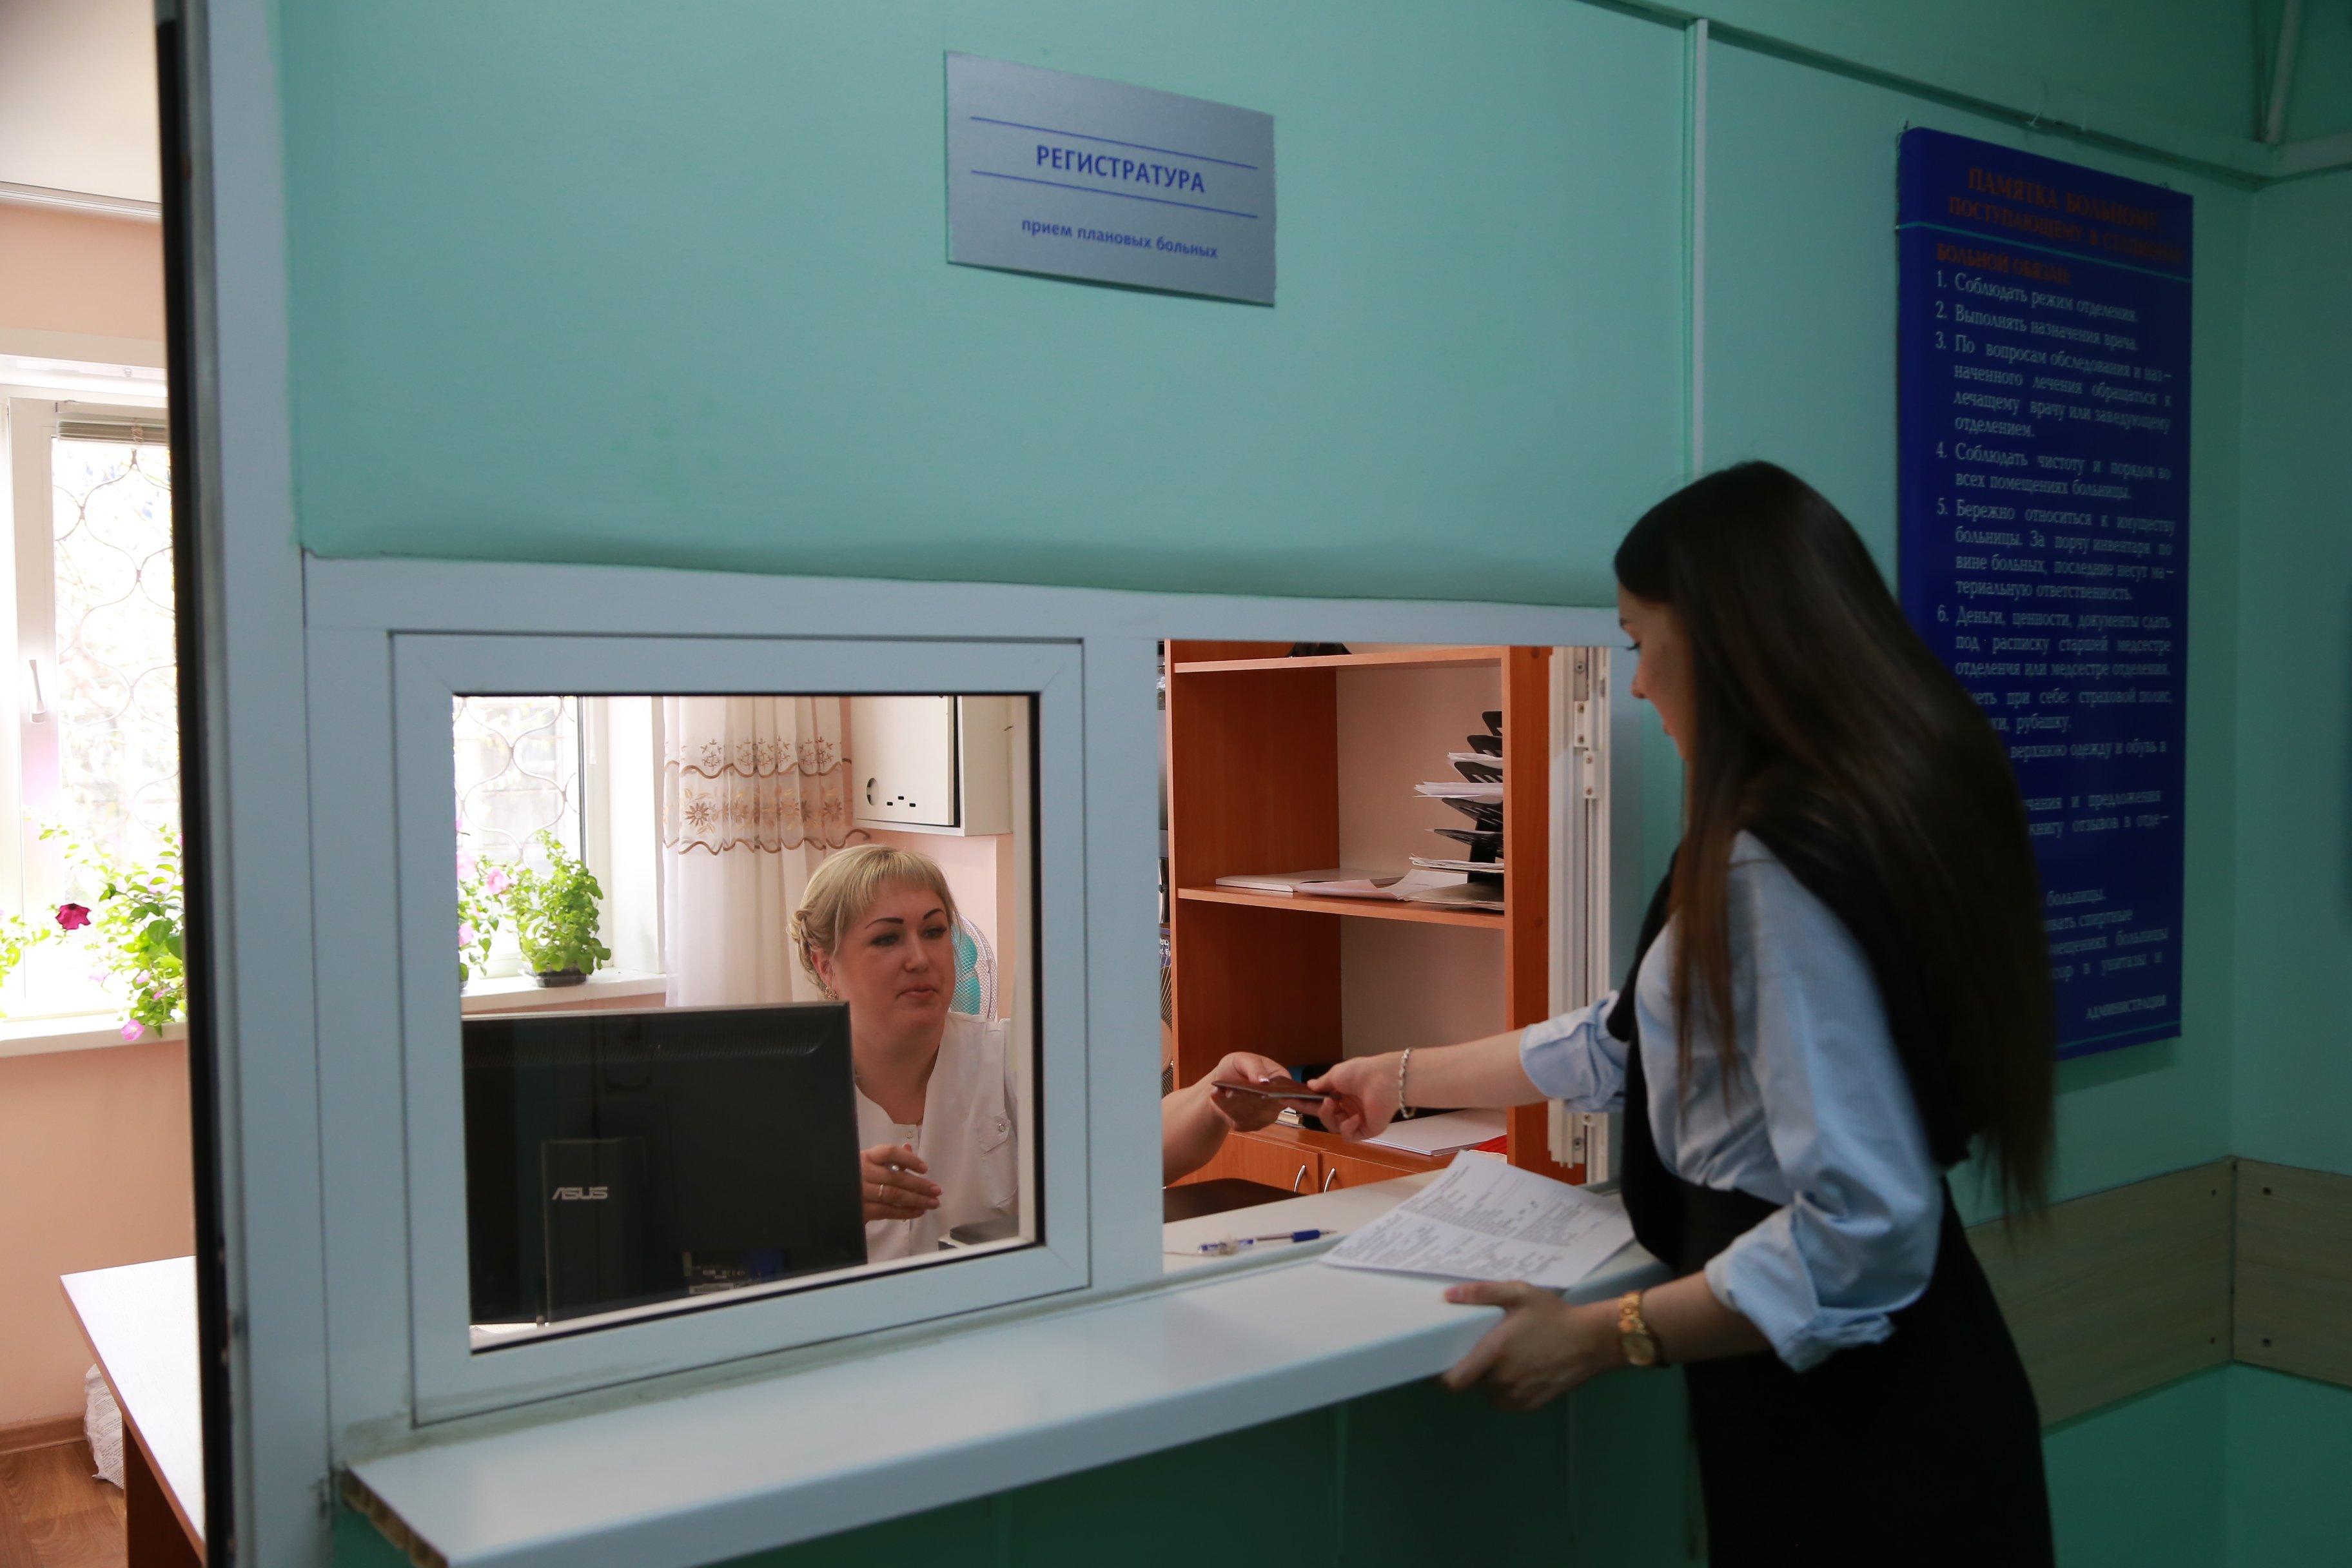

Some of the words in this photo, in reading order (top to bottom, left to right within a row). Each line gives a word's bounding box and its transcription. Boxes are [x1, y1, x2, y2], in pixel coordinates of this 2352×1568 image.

[1036, 144, 1205, 194] РЕГИСТРАТУРА
[1968, 165, 2061, 210] ПАМЯТКА
[1021, 219, 1072, 237] прием
[1077, 227, 1152, 249] плановых
[1156, 235, 1219, 259] больных
[1935, 242, 2010, 271] БОЛЬНОЙ
[1936, 270, 1948, 288] 1.
[1955, 273, 2028, 302] Соблюдать
[2031, 291, 2073, 311] режим
[2076, 300, 2139, 324] отделения.
[1936, 300, 1948, 318] 2.
[1955, 304, 2028, 332] Выполнять
[2030, 320, 2102, 345] назначения
[2104, 332, 2139, 351] врача.
[1936, 330, 1947, 349] 3.
[1955, 334, 1975, 355] По
[1986, 343, 2048, 364] вопросам
[2050, 351, 2131, 378] обследования
[1954, 364, 2024, 387] наченного
[2032, 376, 2084, 395] лечения
[2091, 381, 2157, 406] обращаться
[2164, 395, 2172, 408] к
[1954, 391, 2021, 416] лечащему
[2030, 401, 2066, 423] врачу
[2068, 406, 2092, 421] или
[2093, 409, 2171, 436] заведующему
[1954, 416, 2036, 438] отделением.
[1936, 441, 1948, 458] 4.
[1955, 442, 2028, 468] Соблюдать
[2037, 455, 2086, 476] чистоту
[2093, 460, 2101, 474] и
[1955, 473, 1986, 487] всех
[1989, 476, 2068, 496] помещениях
[2072, 478, 2132, 502] больницы.
[1937, 497, 1949, 516] 5.
[1956, 498, 2015, 522] Бережно
[2024, 507, 2093, 527] относиться
[2100, 514, 2109, 528] к
[2116, 515, 2177, 538] имуществу
[1955, 525, 2023, 549] больницы.
[2030, 529, 2045, 548] За
[2053, 536, 2091, 556] порчу
[2092, 538, 2151, 559] инвентаря
[1955, 555, 1986, 570] вине
[1991, 553, 2047, 577] больных,
[2053, 560, 2114, 578] последние
[2117, 564, 2149, 583] несут
[1955, 580, 2033, 602] териальную
[2035, 584, 2133, 600] ответственность.
[1937, 603, 1949, 623] 6.
[1955, 605, 2006, 630] Деньги,
[2012, 611, 2072, 629] ценности,
[2077, 614, 2139, 632] документы
[2141, 616, 2170, 631] сдать
[1954, 636, 1981, 652] под
[1992, 638, 2051, 655] расписку
[2058, 634, 2108, 656] старшей
[2116, 640, 2171, 656] медсестре
[2023, 663, 2048, 678] или
[2050, 663, 2110, 680] медсестре
[2112, 663, 2171, 678] отделения.
[2005, 691, 2030, 709] при
[2078, 687, 2137, 709] страховой
[2015, 712, 2071, 734] рубашку.
[2010, 744, 2067, 763] верхнюю
[2070, 742, 2113, 760] одежду
[2115, 742, 2123, 755] и
[2125, 738, 2157, 759] обувь
[2070, 795, 2079, 808] и
[2088, 790, 2161, 812] предложения
[2072, 817, 2119, 832] отзывов
[551, 1186, 609, 1200] ASUS
